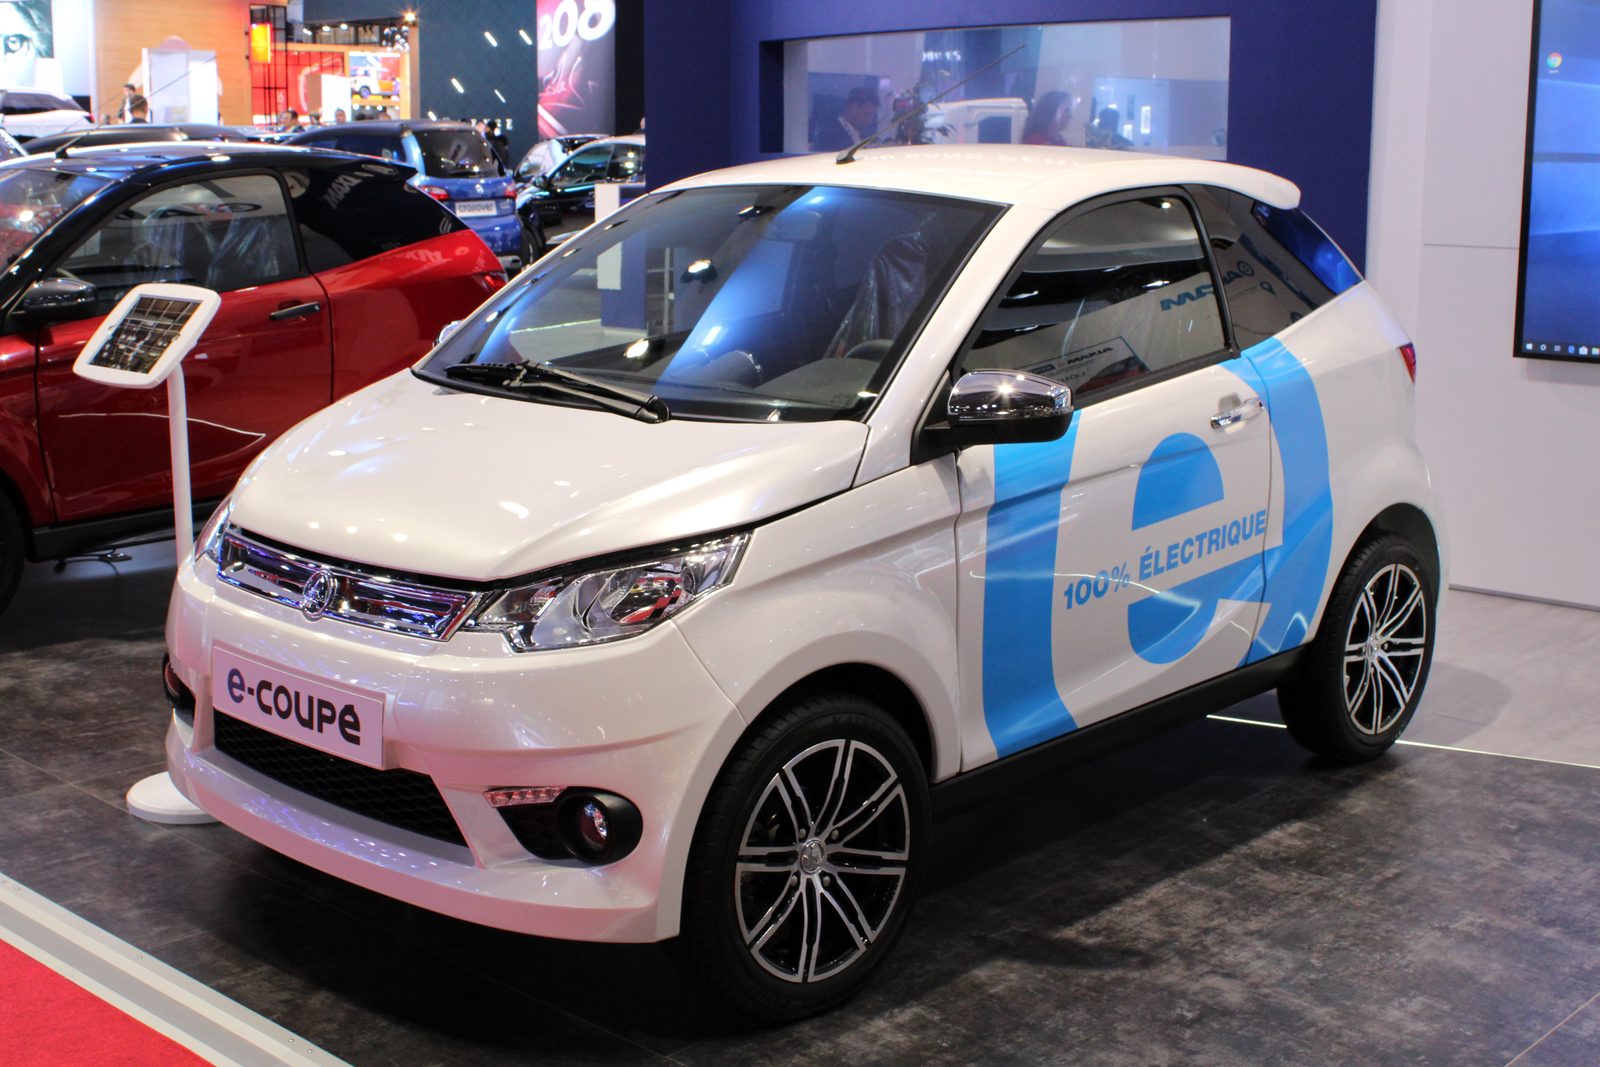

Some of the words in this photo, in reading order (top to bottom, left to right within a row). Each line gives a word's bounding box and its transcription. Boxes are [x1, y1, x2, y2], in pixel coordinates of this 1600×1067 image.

[538, 0, 616, 50] 208
[1063, 562, 1130, 610] 100%
[1139, 508, 1267, 581] ÉLECTRIQUE
